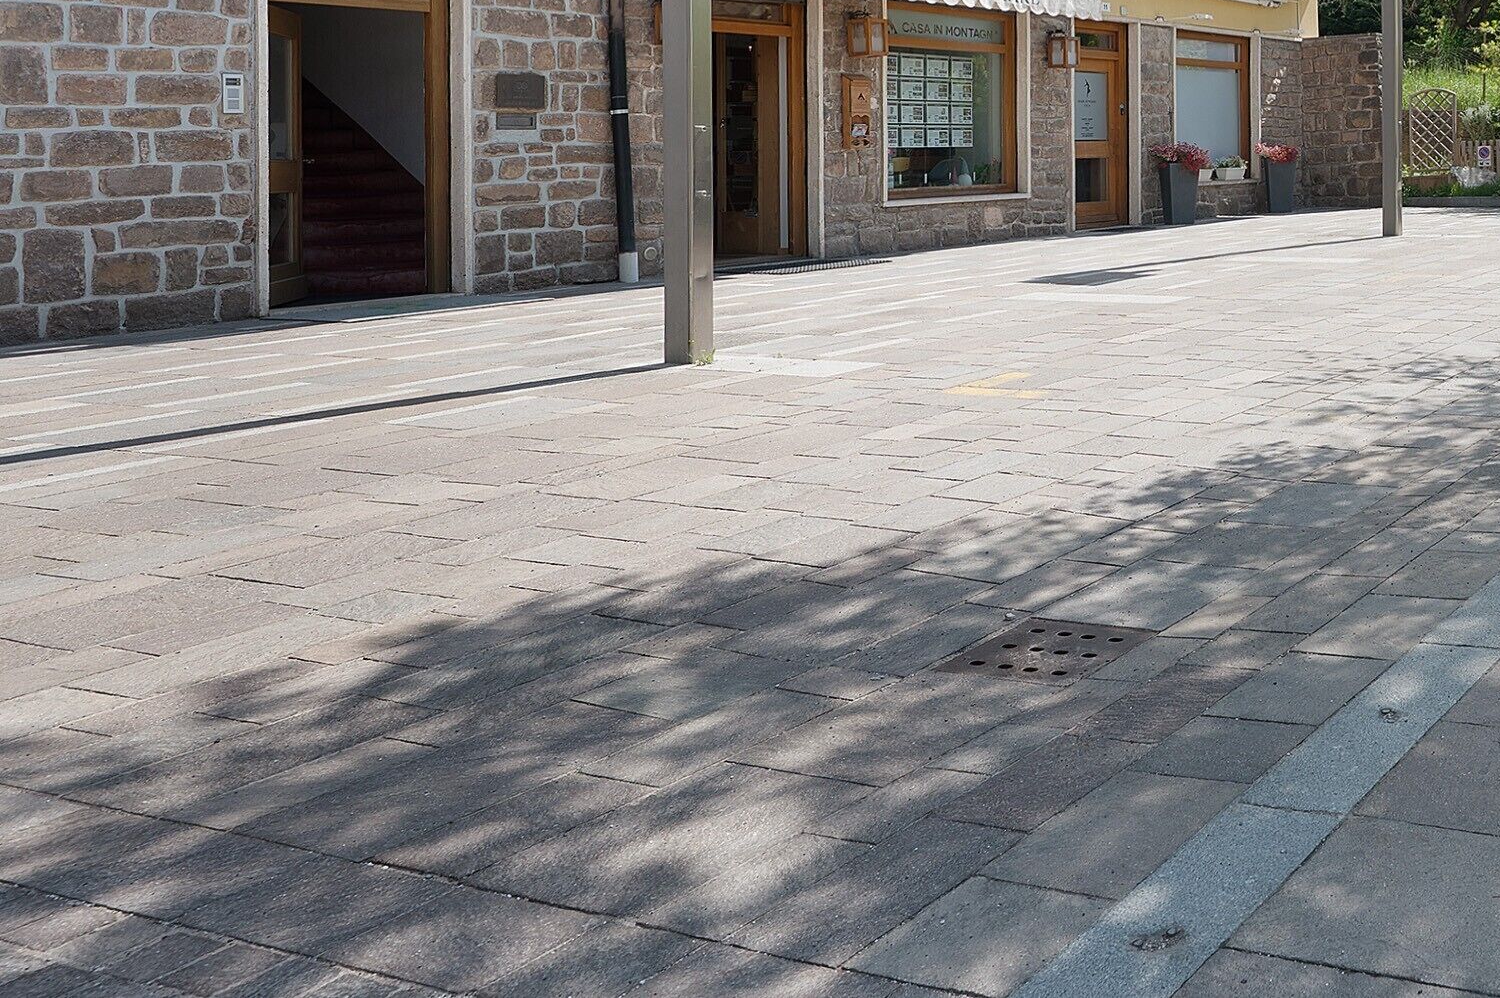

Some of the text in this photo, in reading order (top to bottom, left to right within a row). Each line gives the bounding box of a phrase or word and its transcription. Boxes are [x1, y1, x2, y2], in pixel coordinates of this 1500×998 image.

[902, 22, 998, 39] CASA IN MONTAGN
